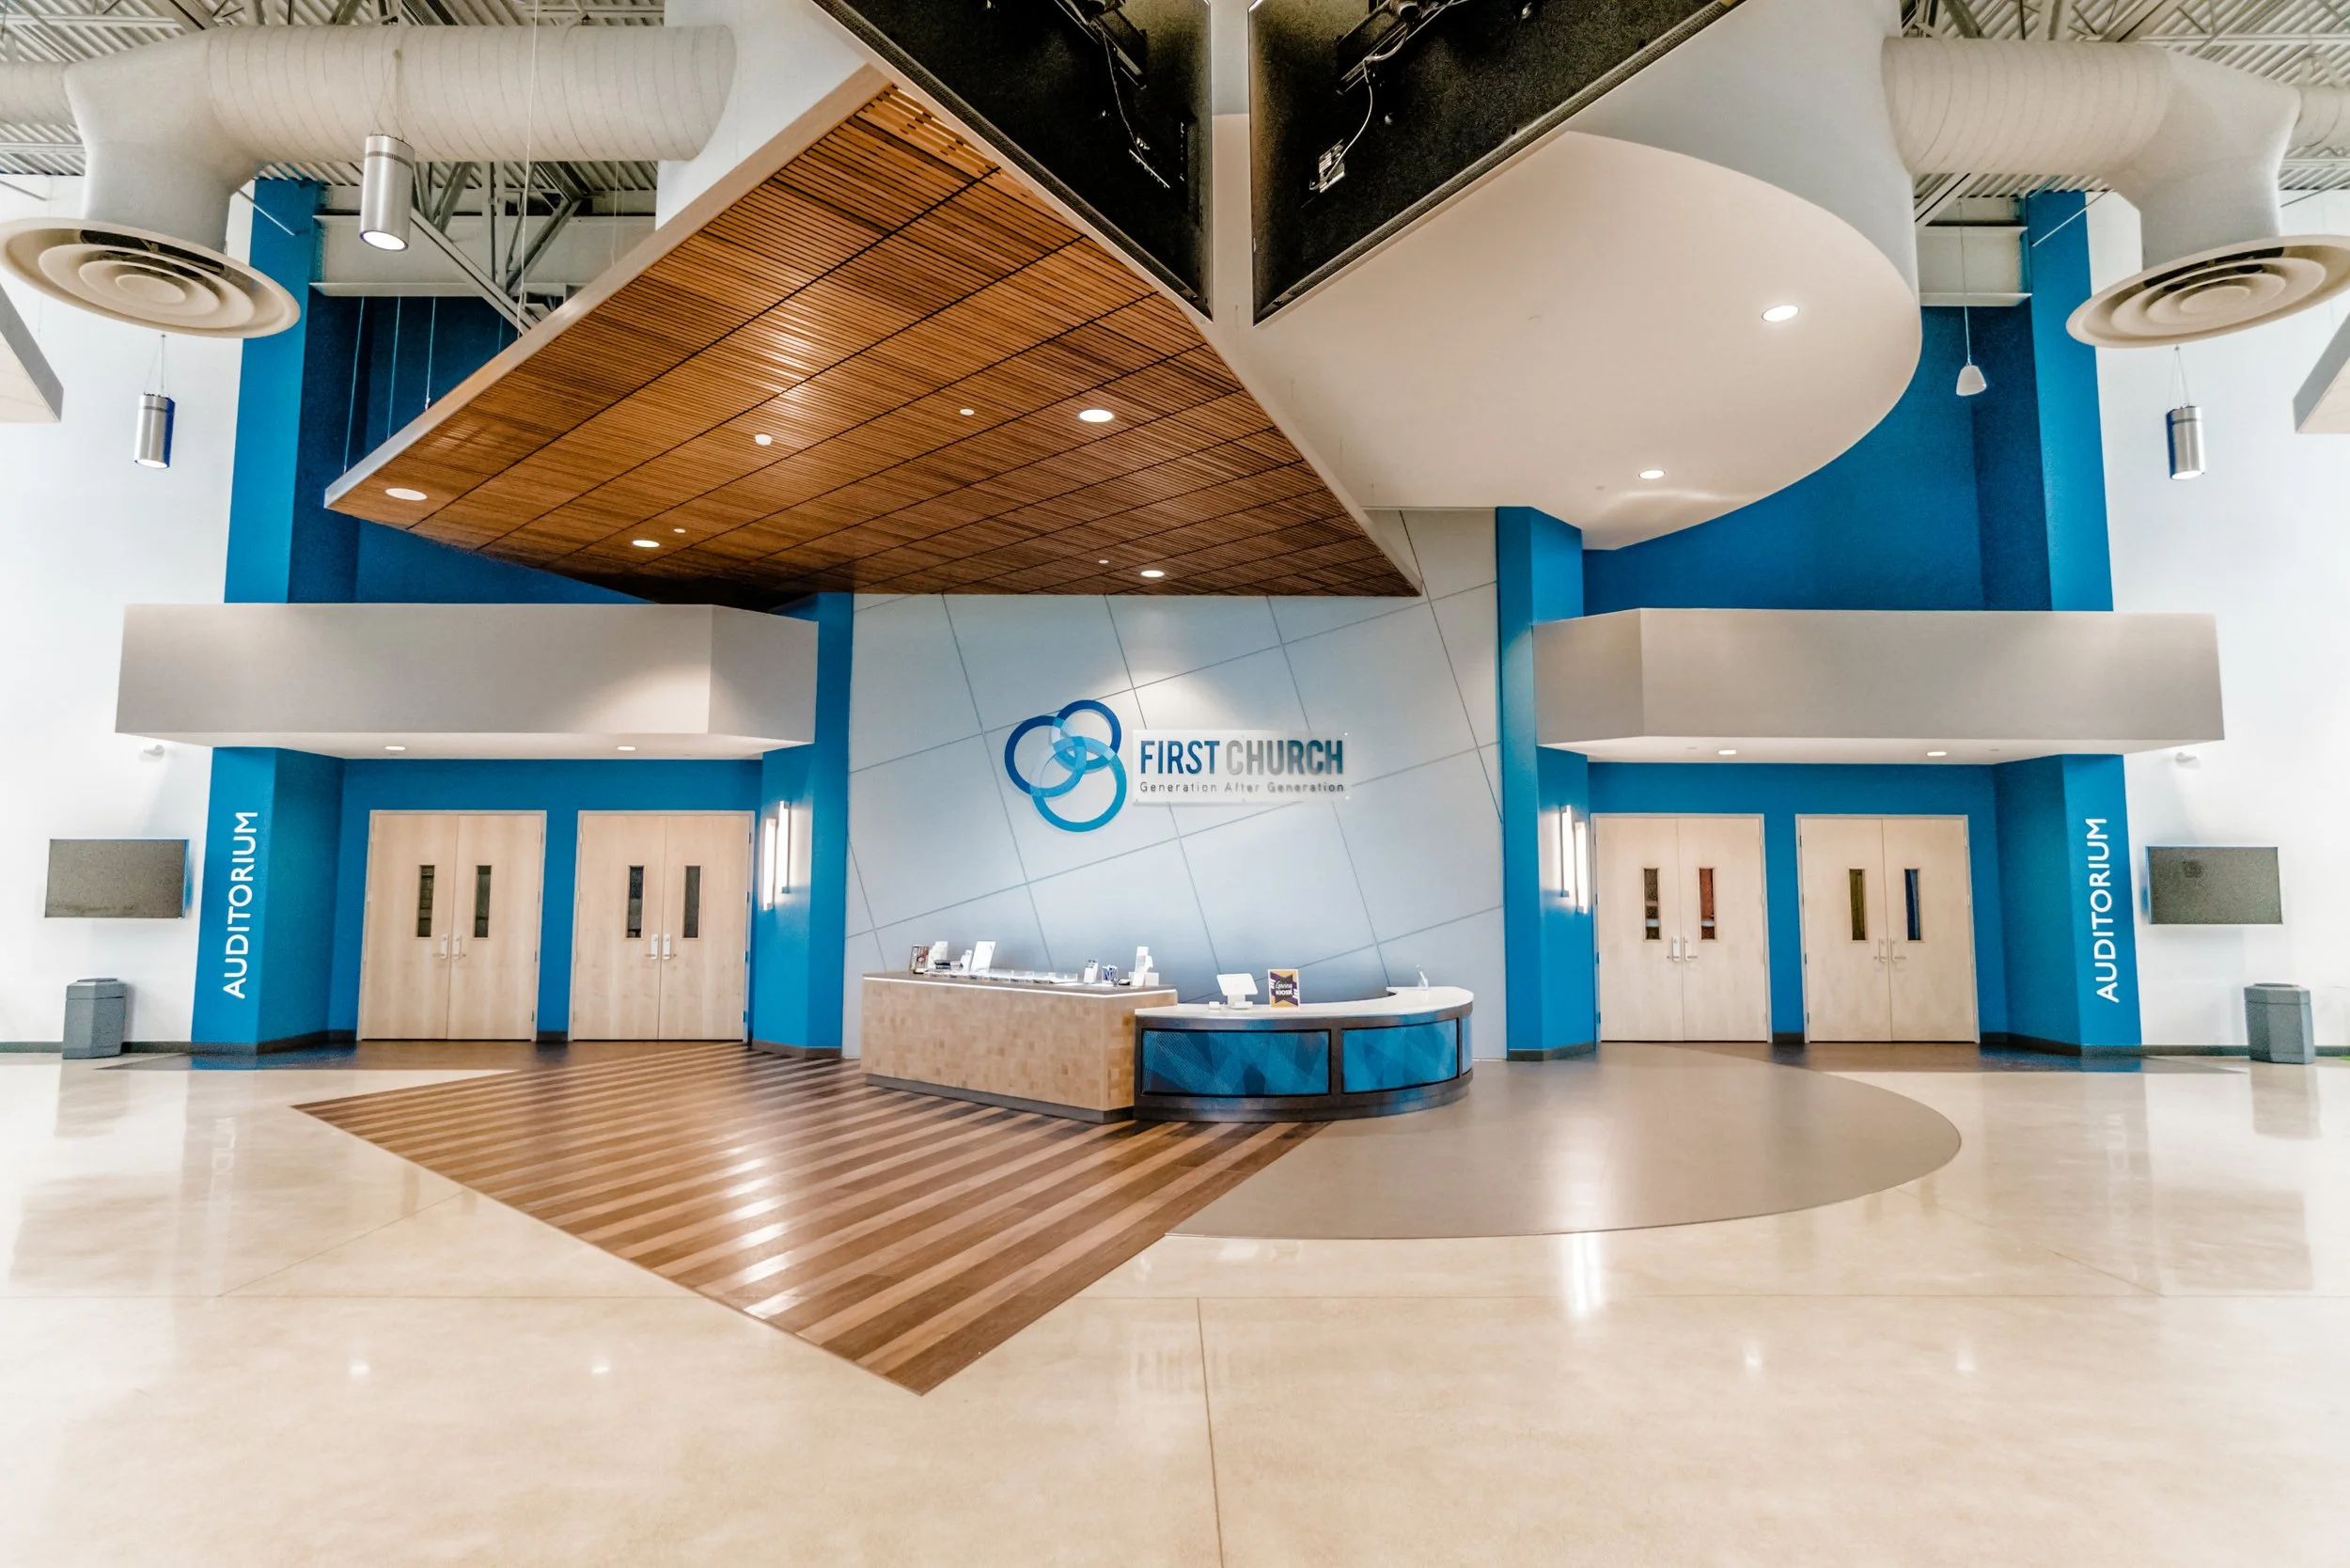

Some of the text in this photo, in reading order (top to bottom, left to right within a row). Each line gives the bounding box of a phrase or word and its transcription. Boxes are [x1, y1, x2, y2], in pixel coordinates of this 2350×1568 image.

[1139, 781, 1344, 793] Generation After Generation
[1140, 740, 1343, 776] FIRST CHURCH
[223, 811, 258, 999] AUDITORIUM
[2085, 818, 2120, 1003] AUDITORIUM
